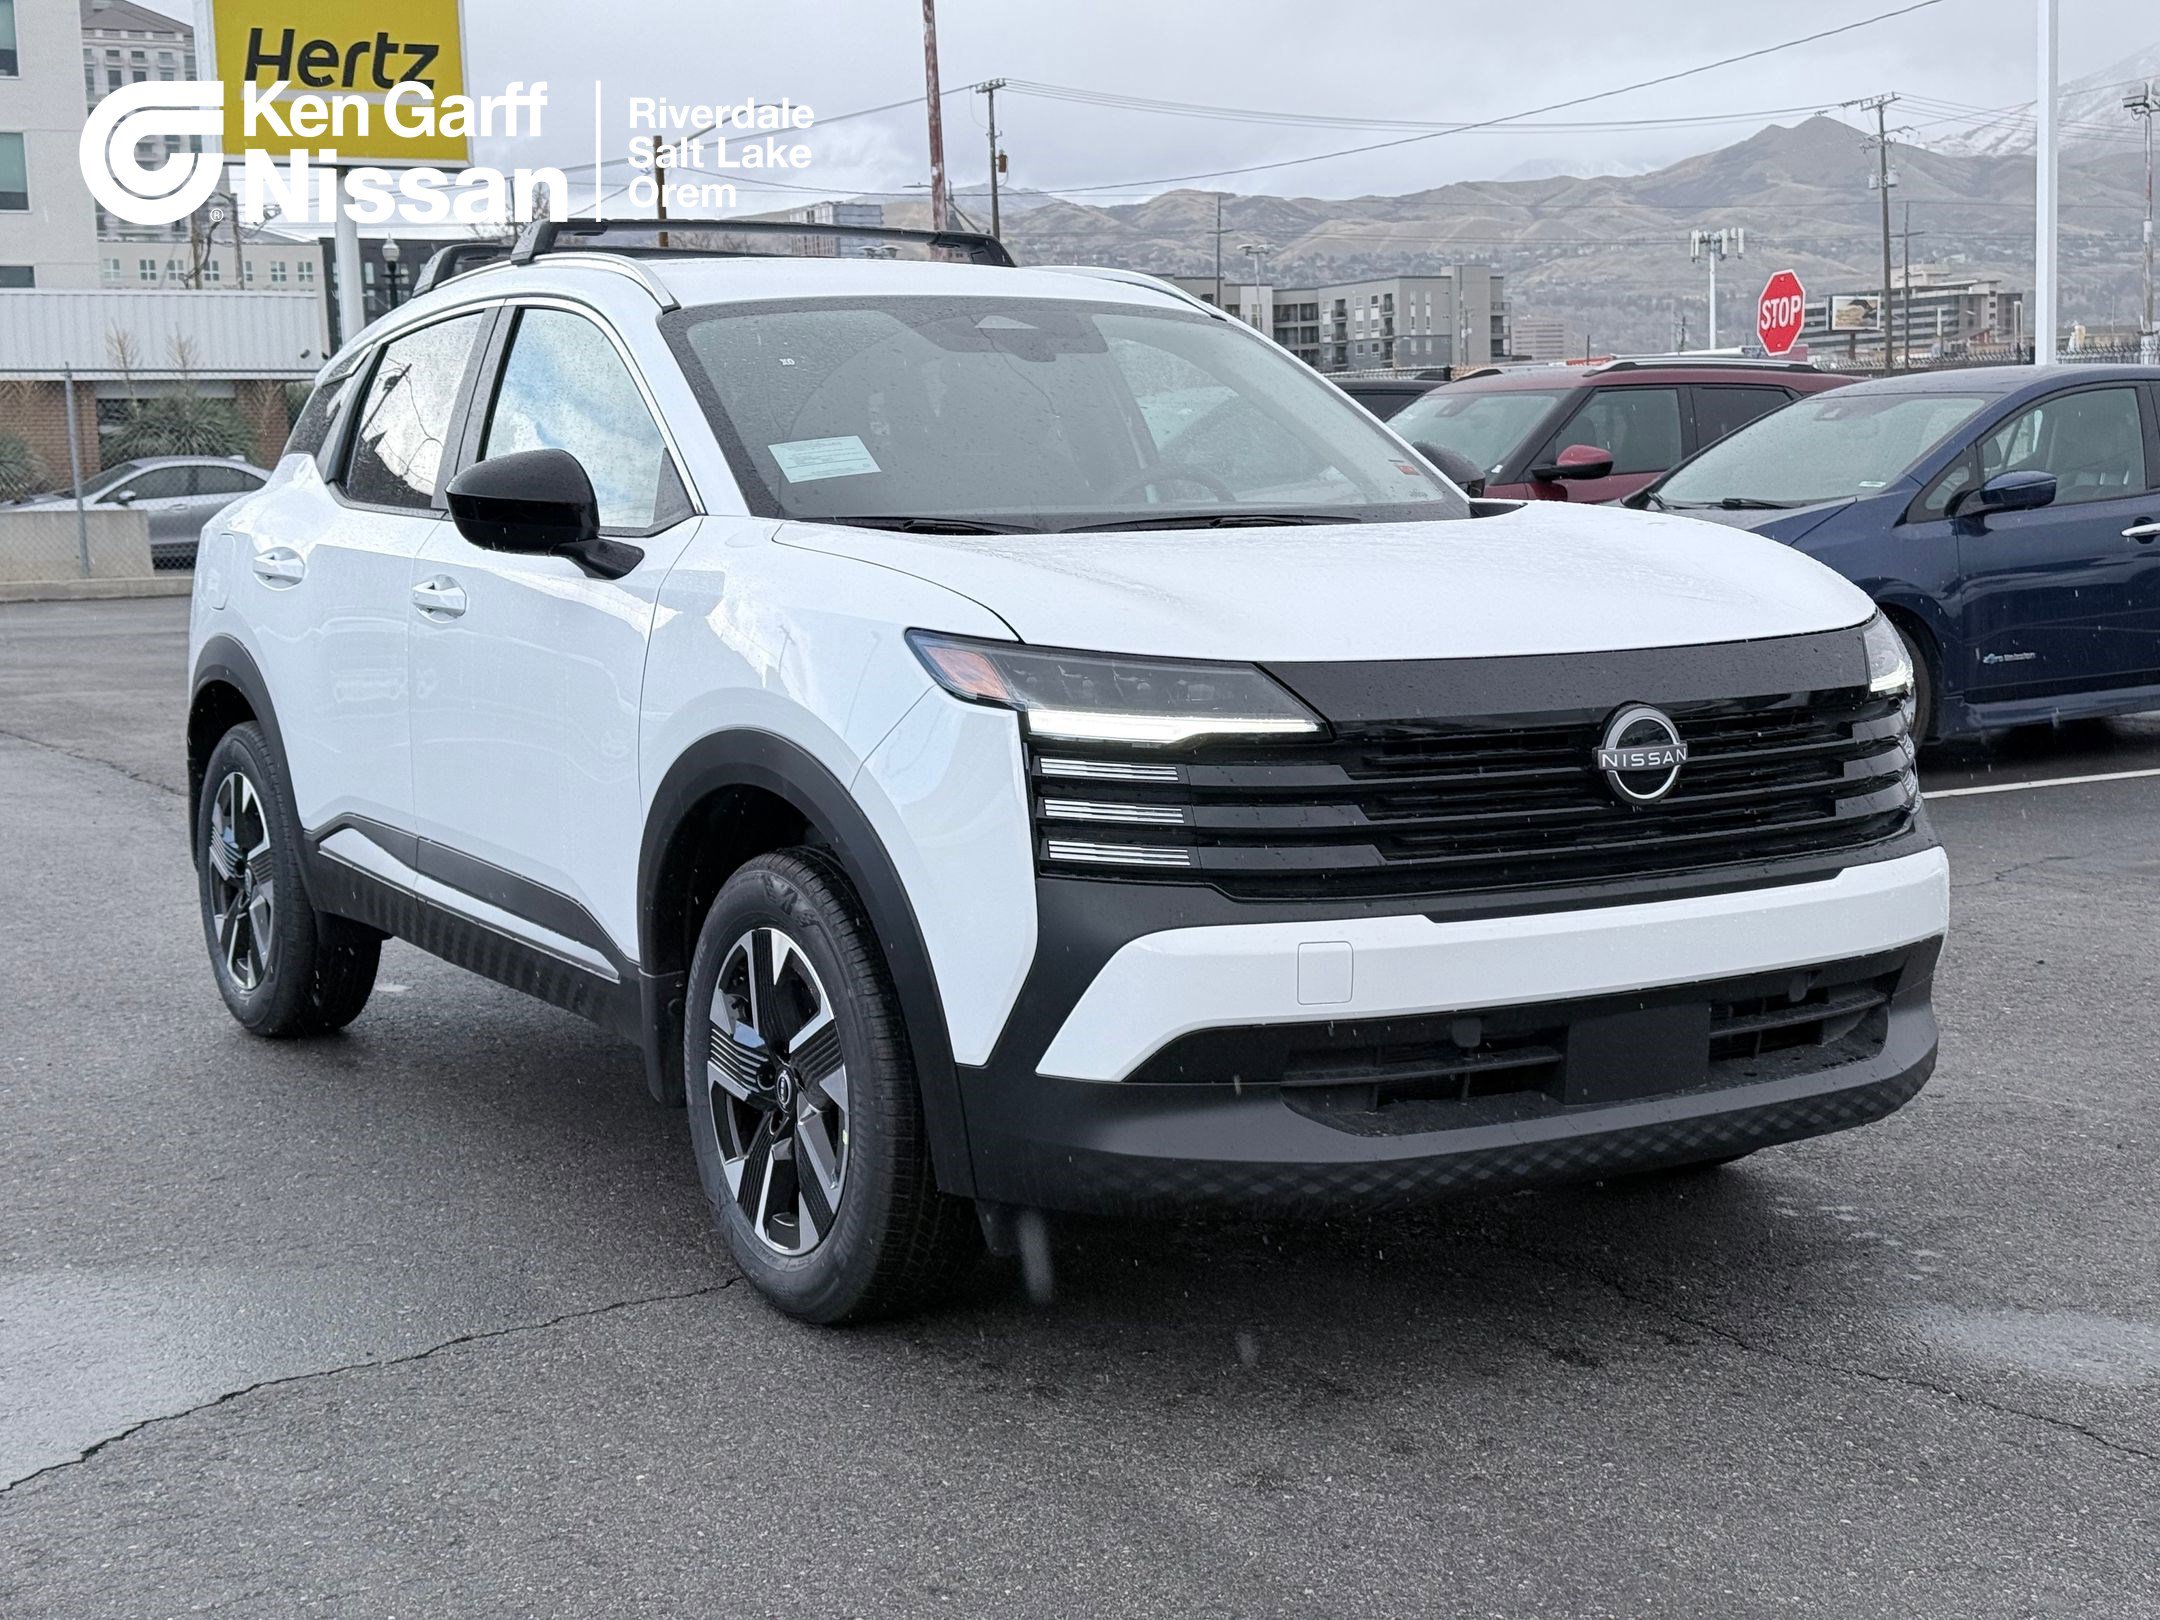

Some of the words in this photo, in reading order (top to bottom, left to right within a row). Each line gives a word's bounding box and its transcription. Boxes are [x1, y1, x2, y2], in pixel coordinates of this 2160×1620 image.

[244, 27, 440, 90] Hertz
[1761, 295, 1801, 331] STOP
[1602, 748, 1687, 768] NISSAN
